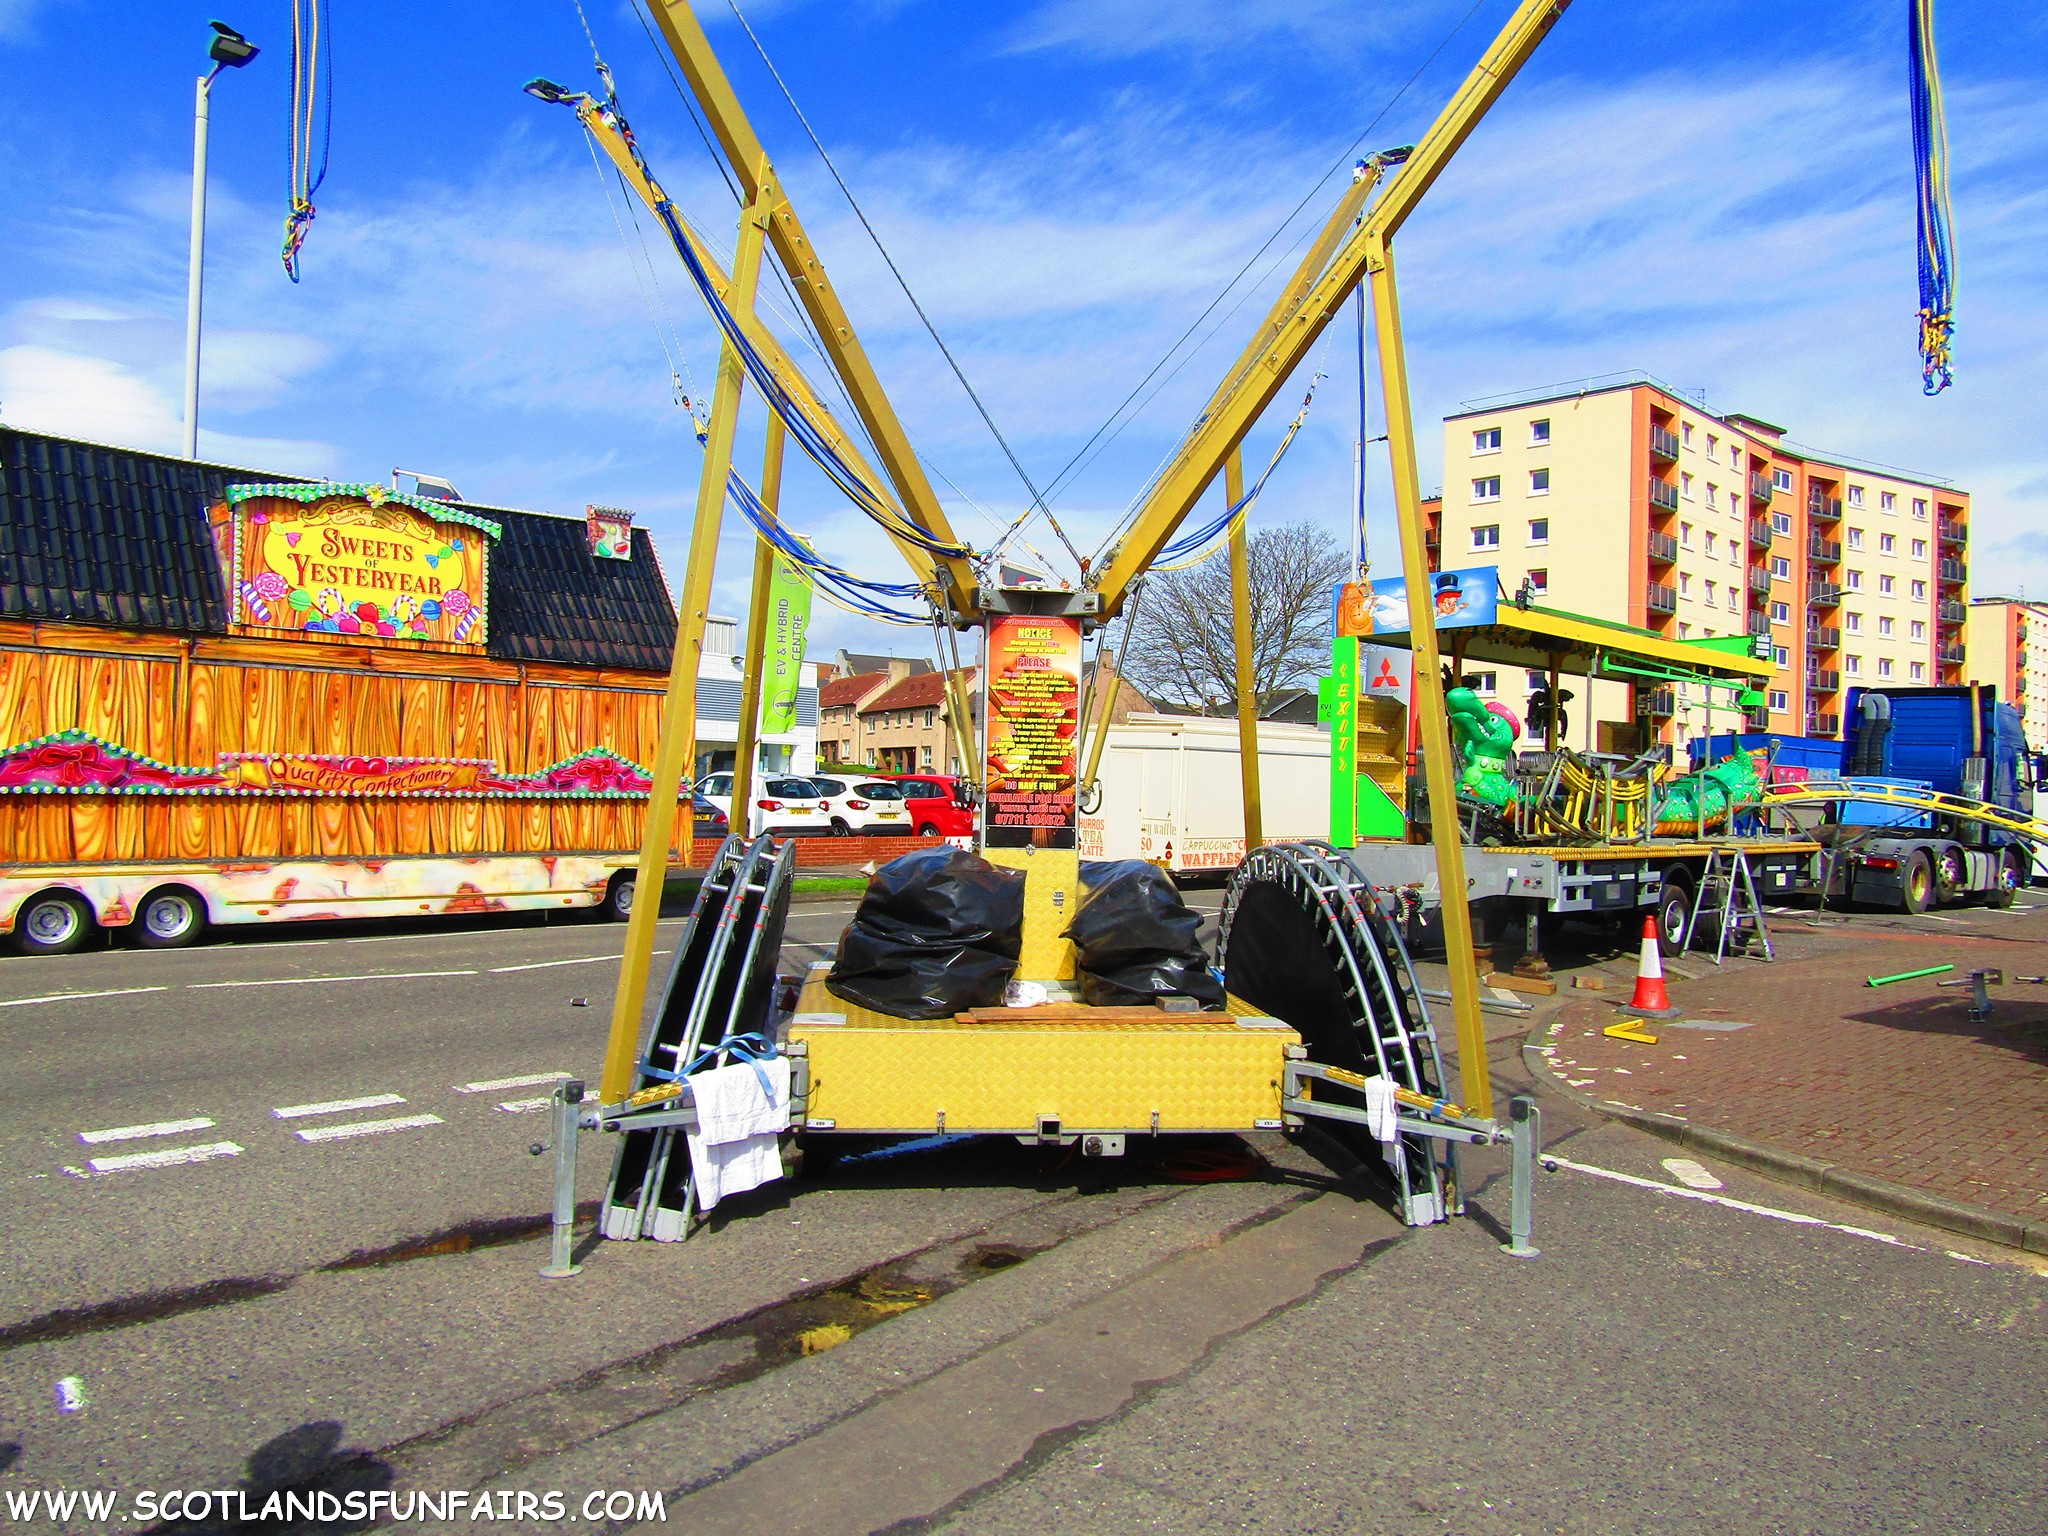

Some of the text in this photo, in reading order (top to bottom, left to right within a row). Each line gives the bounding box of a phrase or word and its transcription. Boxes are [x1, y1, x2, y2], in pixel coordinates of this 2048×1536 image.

[321, 528, 414, 562] SWEETS
[365, 559, 380, 568] OF
[287, 553, 442, 596] YESTERYEAR
[776, 598, 789, 675] EV & HYBRID
[791, 614, 804, 661] CENTRE
[1017, 627, 1053, 638] NOTICE
[1017, 656, 1052, 668] PLEASE
[1336, 683, 1351, 752] EXIT
[269, 756, 455, 793] Quality Confectionery
[1005, 781, 1017, 790] DO
[1018, 781, 1038, 790] HAVE
[988, 793, 1074, 804] AVAILABLE FOR HIRE
[995, 813, 1024, 825] 07711
[1079, 818, 1105, 831] HURROS
[1153, 822, 1177, 836] waffle
[1082, 830, 1103, 845] TEA
[1082, 845, 1104, 857] LATTE
[1182, 839, 1232, 851] CAPPUCCINO
[1181, 851, 1242, 868] WAFFLES
